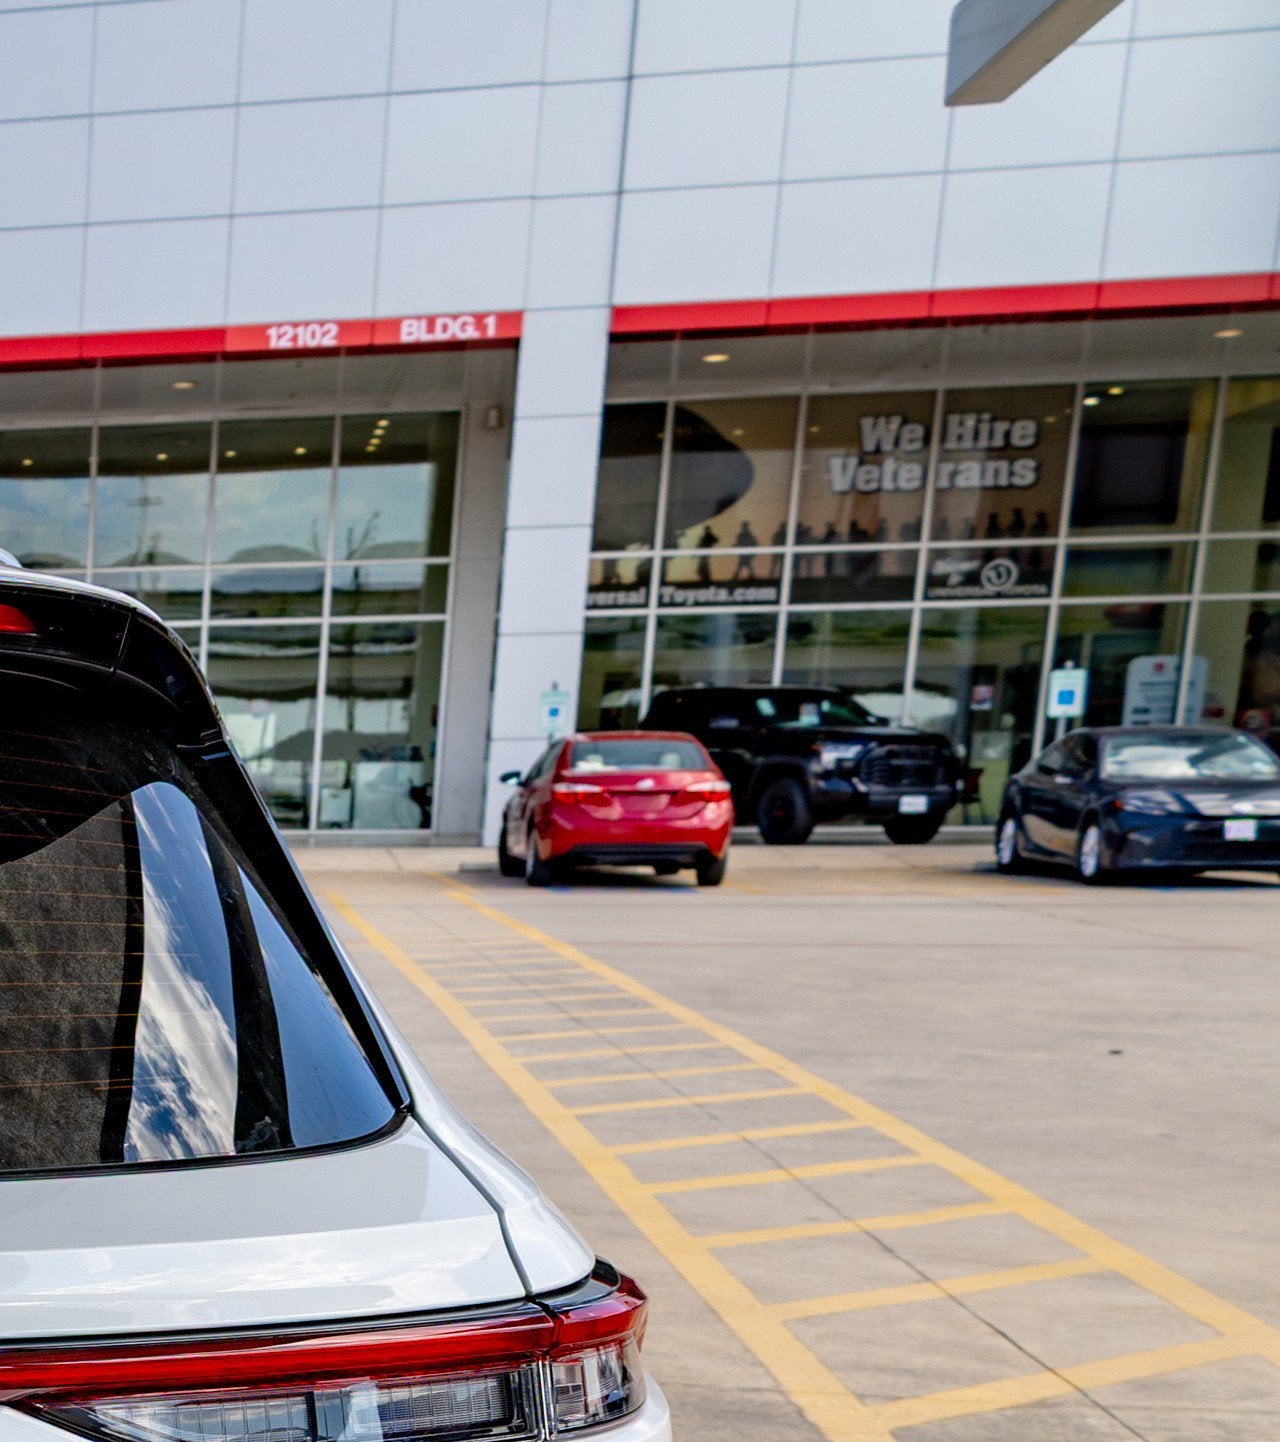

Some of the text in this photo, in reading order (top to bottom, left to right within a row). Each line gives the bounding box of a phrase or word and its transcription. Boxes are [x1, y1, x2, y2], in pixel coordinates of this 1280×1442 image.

[266, 322, 339, 349] 12102
[399, 314, 498, 343] BLDG. 1
[859, 412, 1037, 451] We Hire
[828, 456, 1038, 493] Veterans
